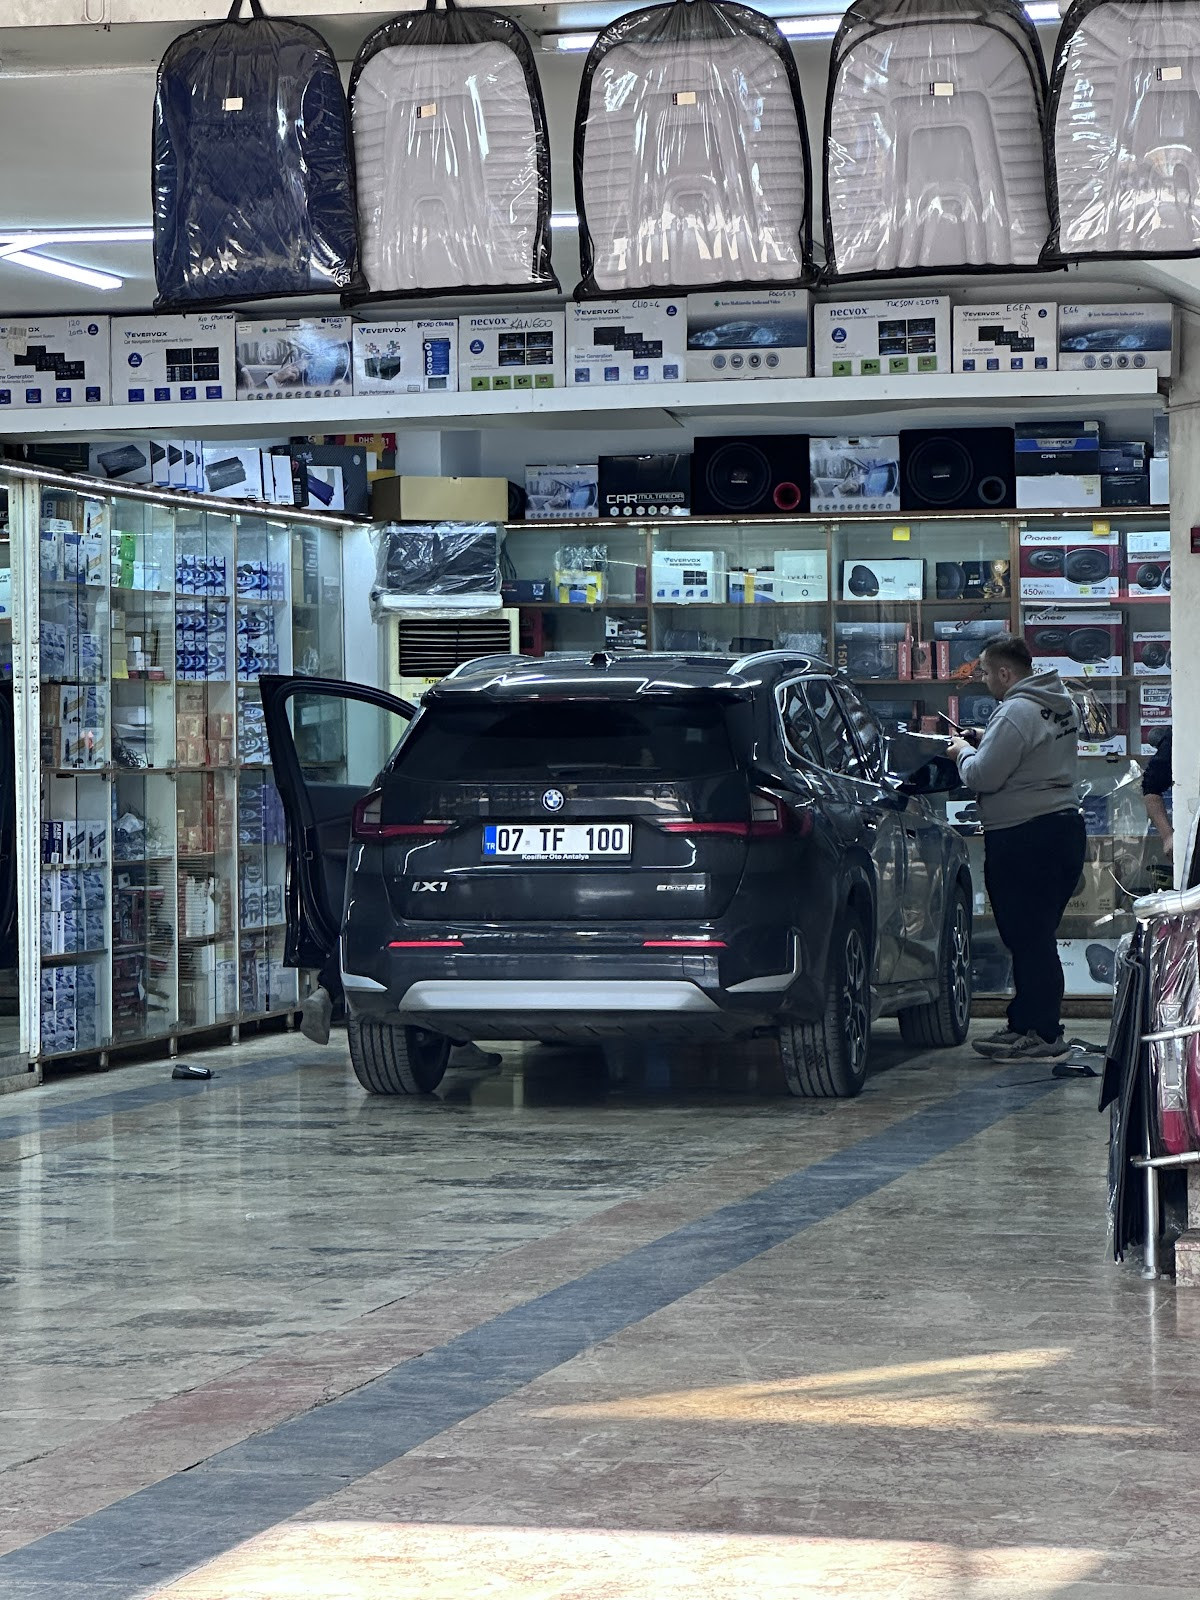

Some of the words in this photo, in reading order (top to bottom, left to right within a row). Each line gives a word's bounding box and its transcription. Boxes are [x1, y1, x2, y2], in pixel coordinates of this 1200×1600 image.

[830, 307, 868, 316] necvox
[1007, 304, 1031, 312] EGEA
[470, 318, 507, 326] necvox
[606, 494, 637, 504] CAR
[638, 492, 684, 501] MULTIMEDIA
[499, 828, 523, 851] 07
[540, 828, 565, 851] TF
[586, 827, 623, 851] 100
[412, 881, 448, 892] iX1
